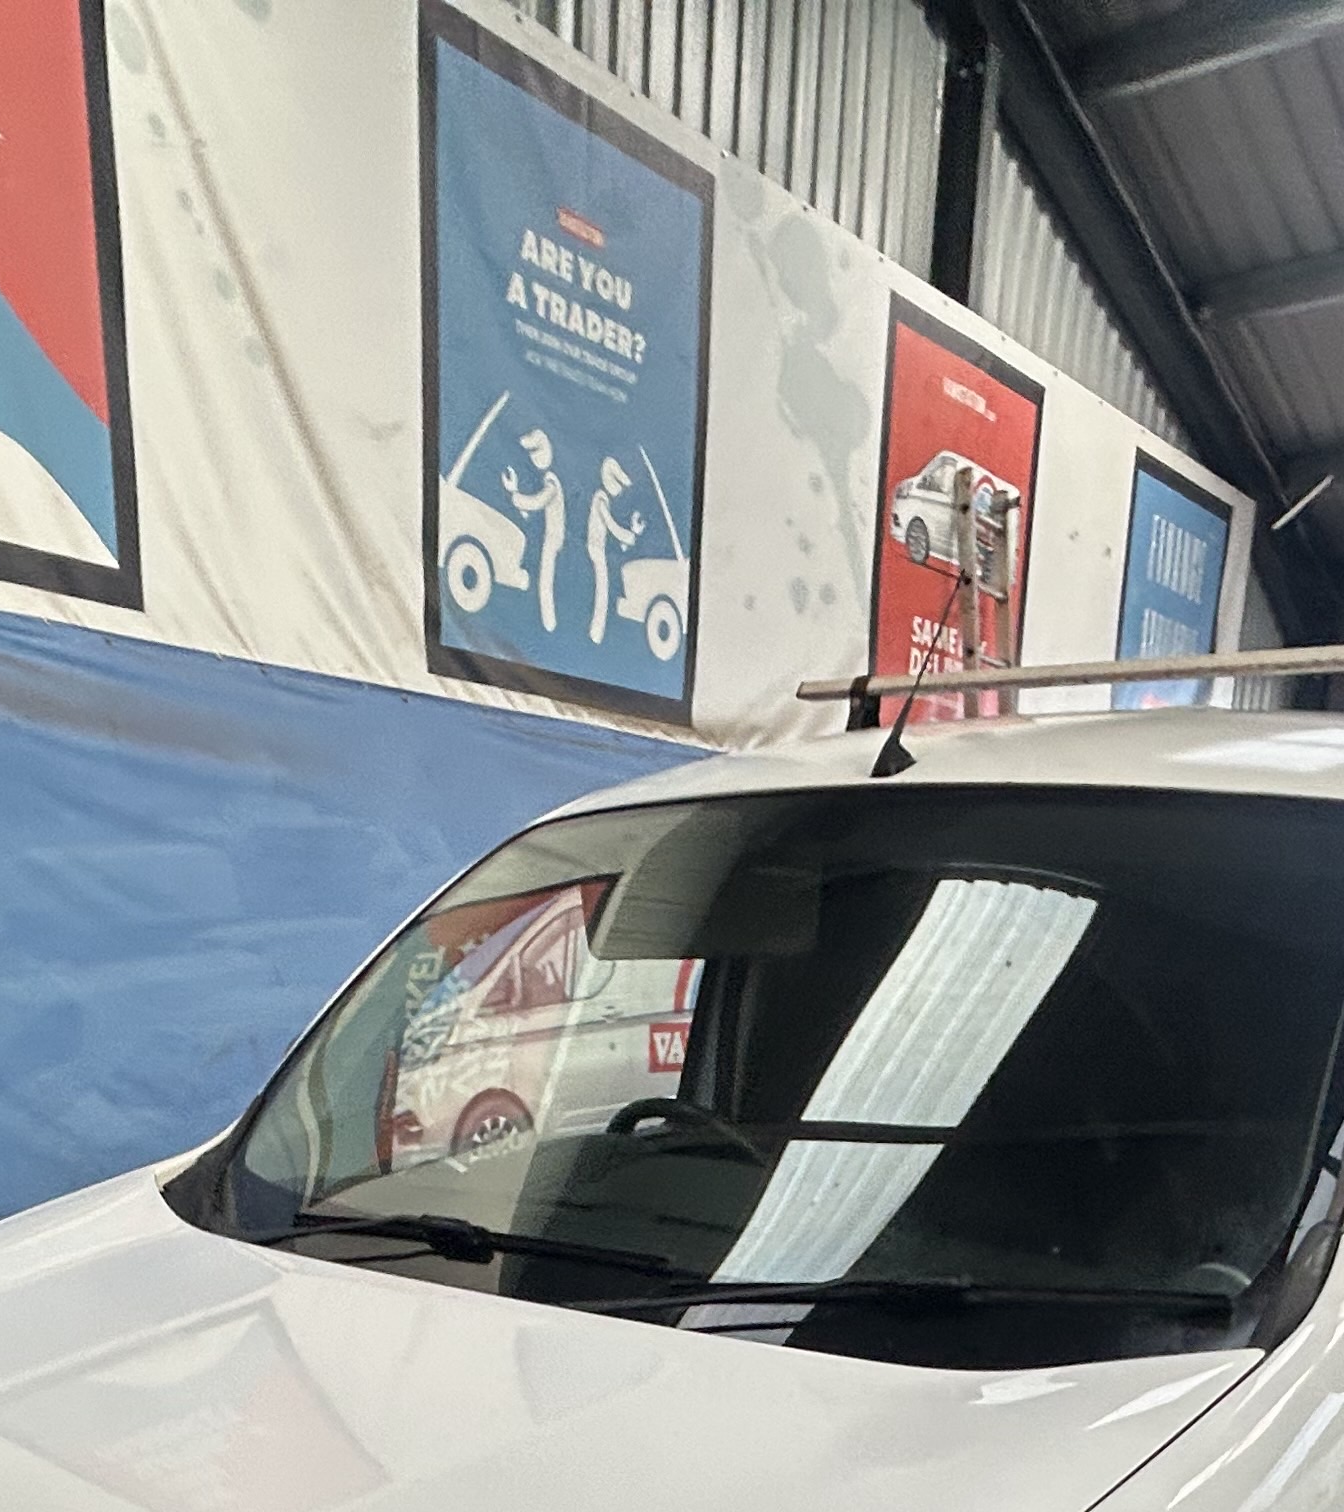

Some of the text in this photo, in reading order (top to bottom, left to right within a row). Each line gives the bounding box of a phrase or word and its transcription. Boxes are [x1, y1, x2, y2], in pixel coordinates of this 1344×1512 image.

[520, 228, 573, 283] ARE
[576, 253, 632, 311] YOU
[505, 271, 528, 309] A
[531, 281, 646, 364] TRADER?
